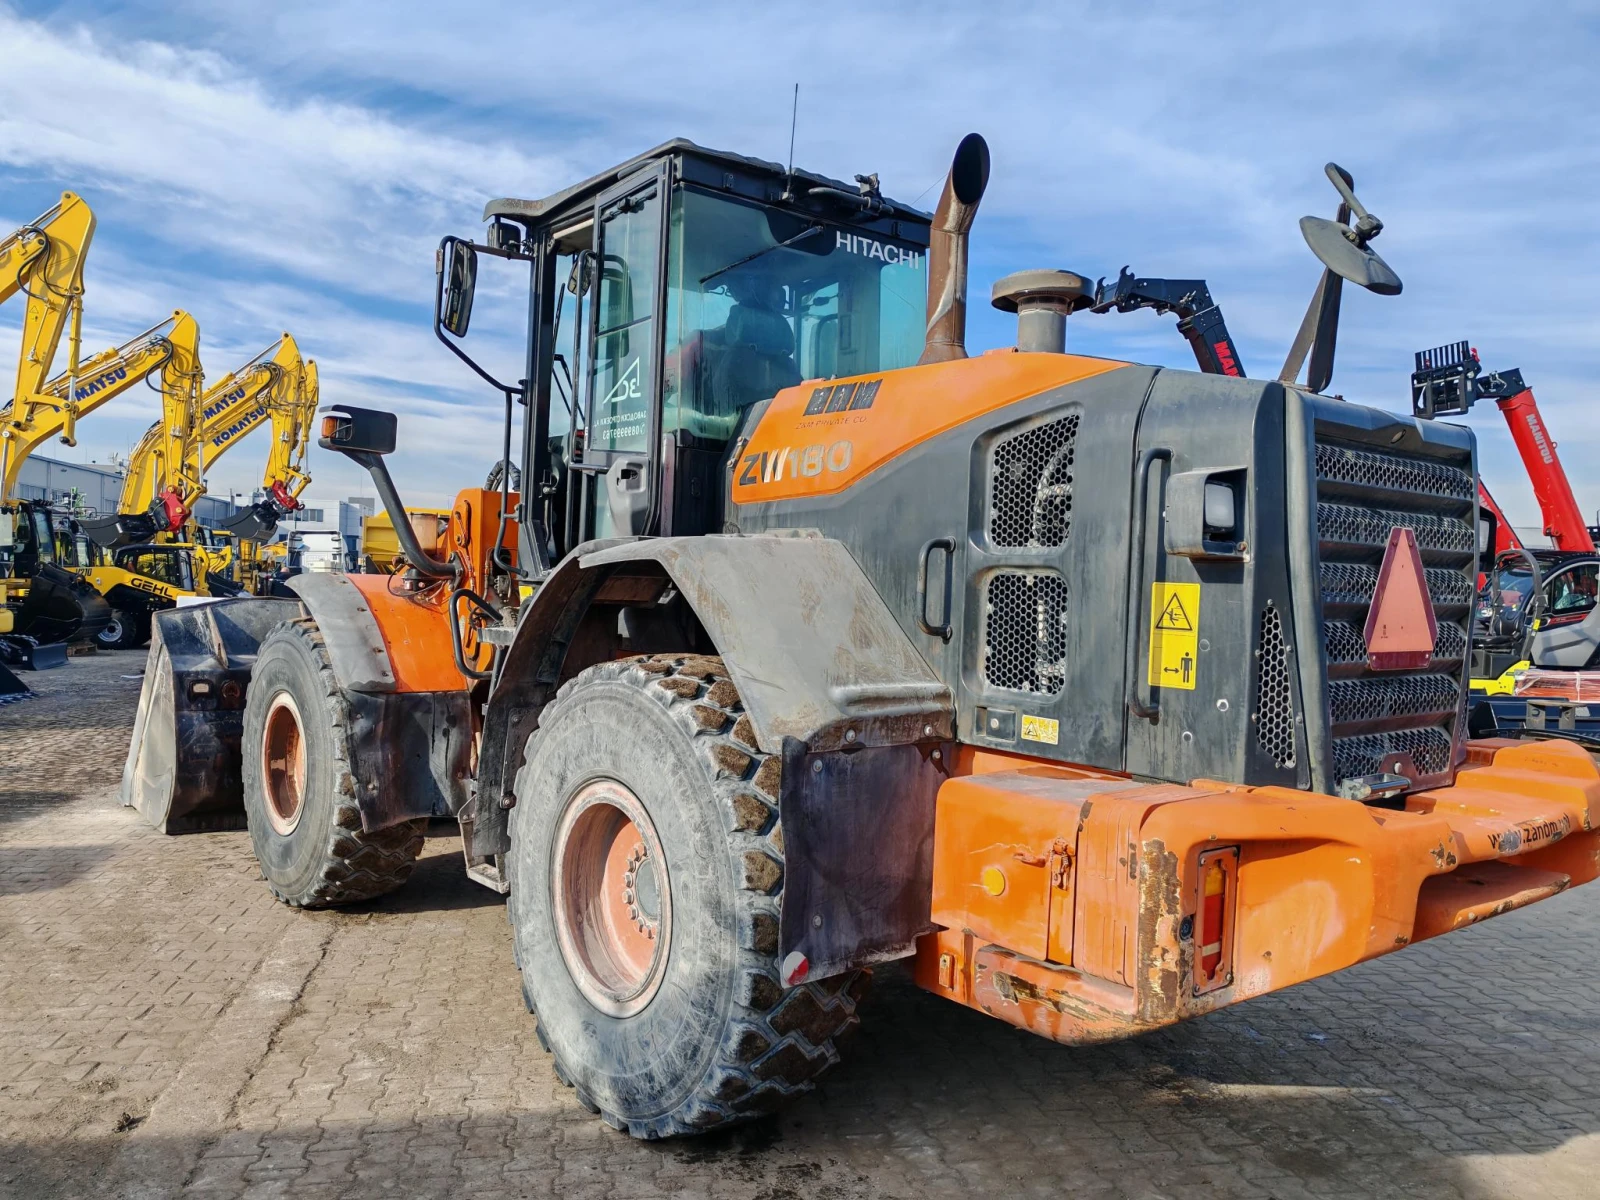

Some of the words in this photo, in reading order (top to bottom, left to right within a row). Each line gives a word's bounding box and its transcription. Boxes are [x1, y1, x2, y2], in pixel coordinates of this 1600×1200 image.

[836, 230, 918, 269] HITACHI
[203, 387, 246, 421] MATSU
[212, 405, 266, 447] KOMATSU
[1526, 413, 1553, 464] MANITOU
[739, 440, 853, 486] ZW180
[131, 578, 174, 598] GEHL
